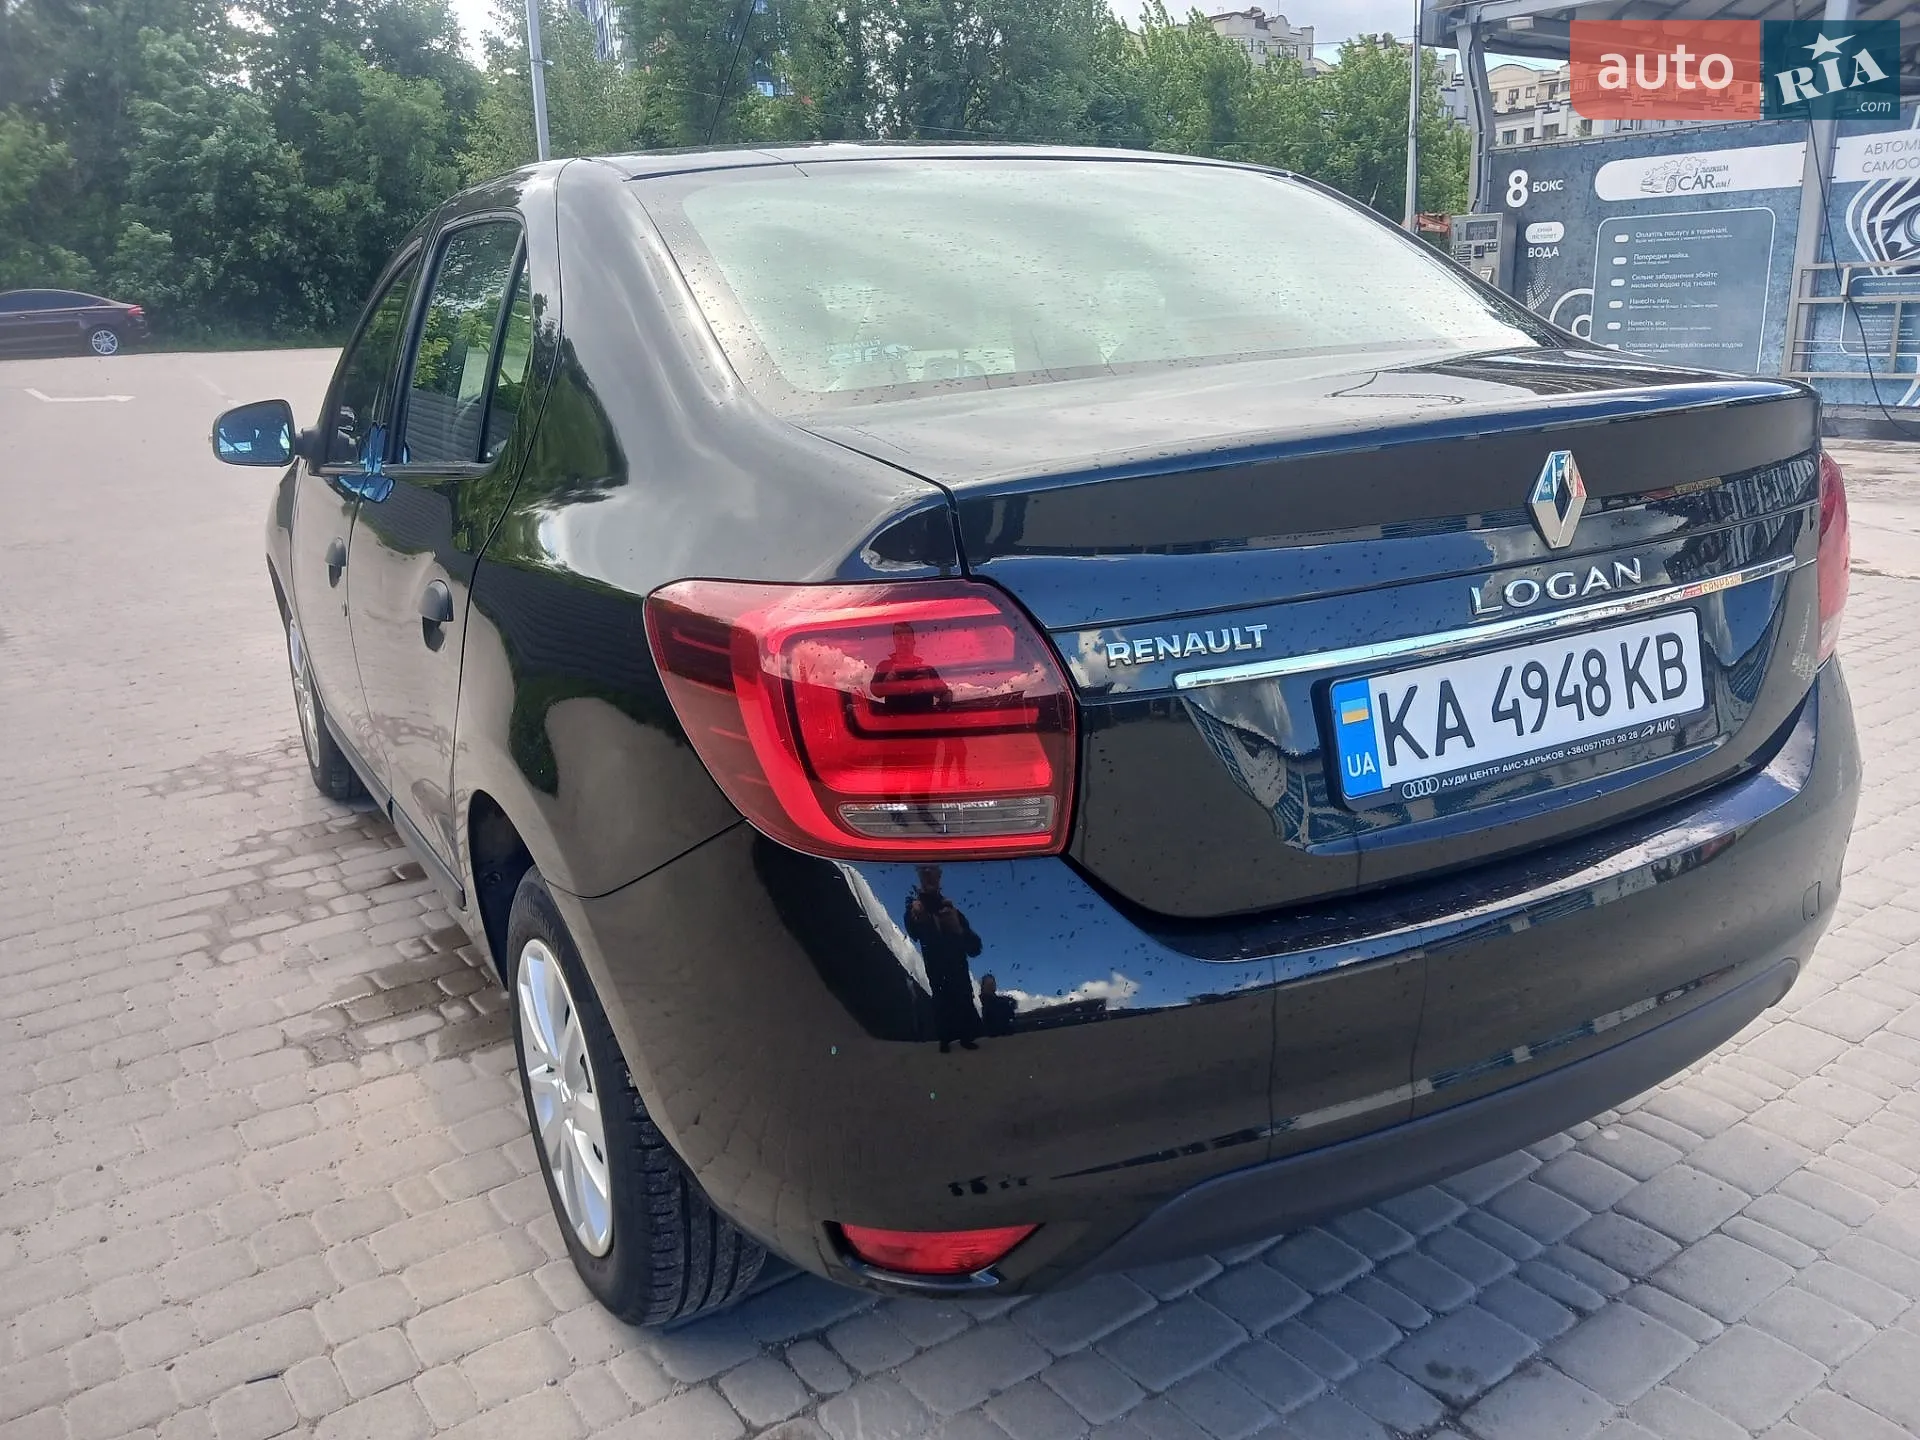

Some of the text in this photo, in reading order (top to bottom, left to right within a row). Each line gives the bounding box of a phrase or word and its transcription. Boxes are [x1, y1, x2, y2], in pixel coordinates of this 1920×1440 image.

[1505, 168, 1565, 208] 8 БОКС
[1527, 246, 1560, 259] ВОДА
[1470, 556, 1643, 616] LOGAN
[1106, 622, 1269, 668] RENAULT
[1378, 632, 1689, 768] KA 4948 KB
[1656, 718, 1677, 733] АИС
[1346, 753, 1378, 778] UA
[1441, 730, 1639, 788] АУДИ ЦЕНТР АИС-ХАРЬКОВ +38(057)703 20 28
